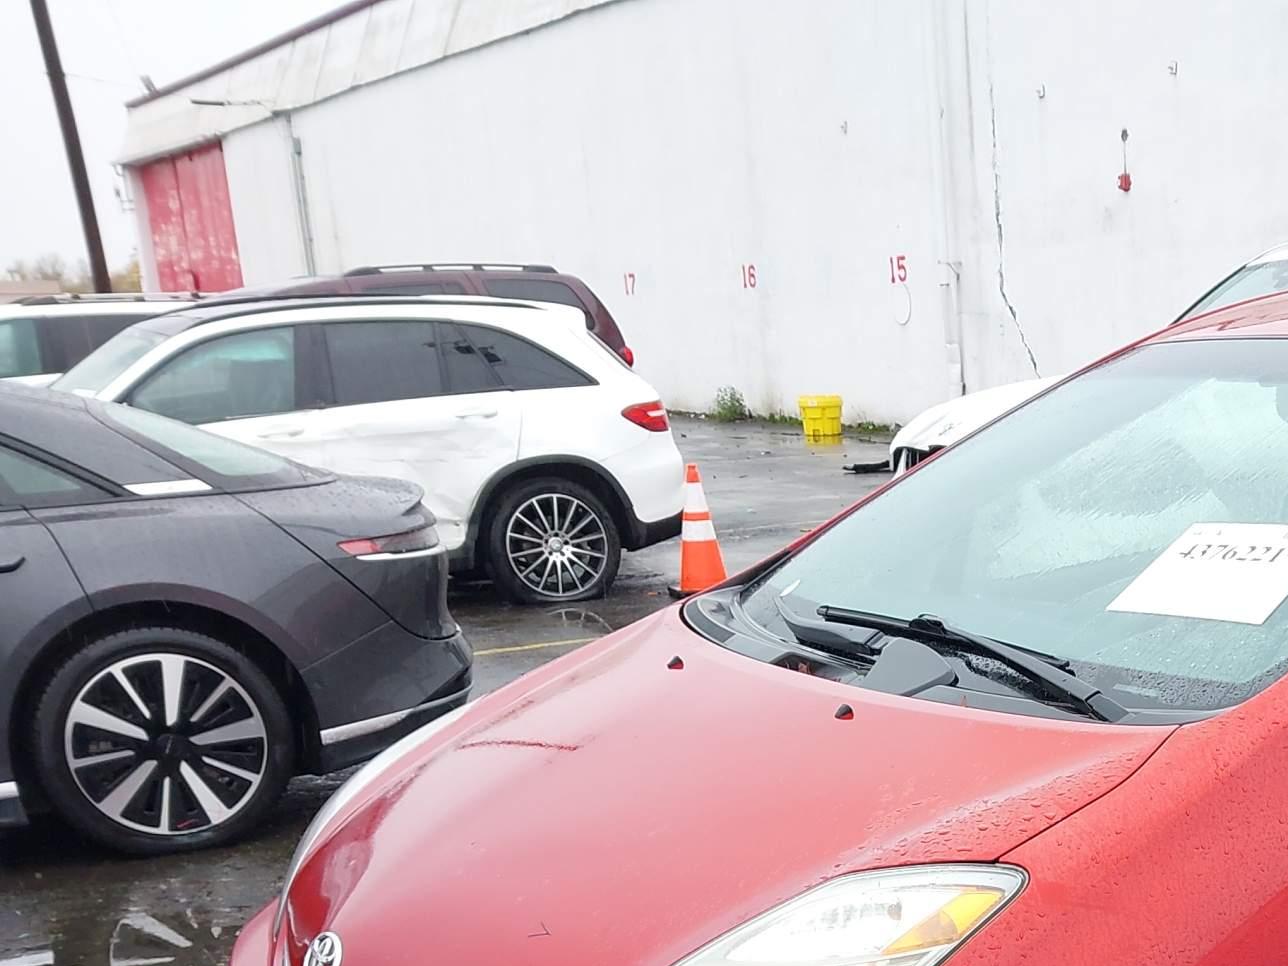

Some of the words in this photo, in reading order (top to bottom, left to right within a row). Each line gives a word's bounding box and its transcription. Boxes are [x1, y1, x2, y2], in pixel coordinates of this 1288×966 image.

[741, 264, 758, 289] 16
[889, 255, 908, 284] 15
[623, 272, 636, 296] 17
